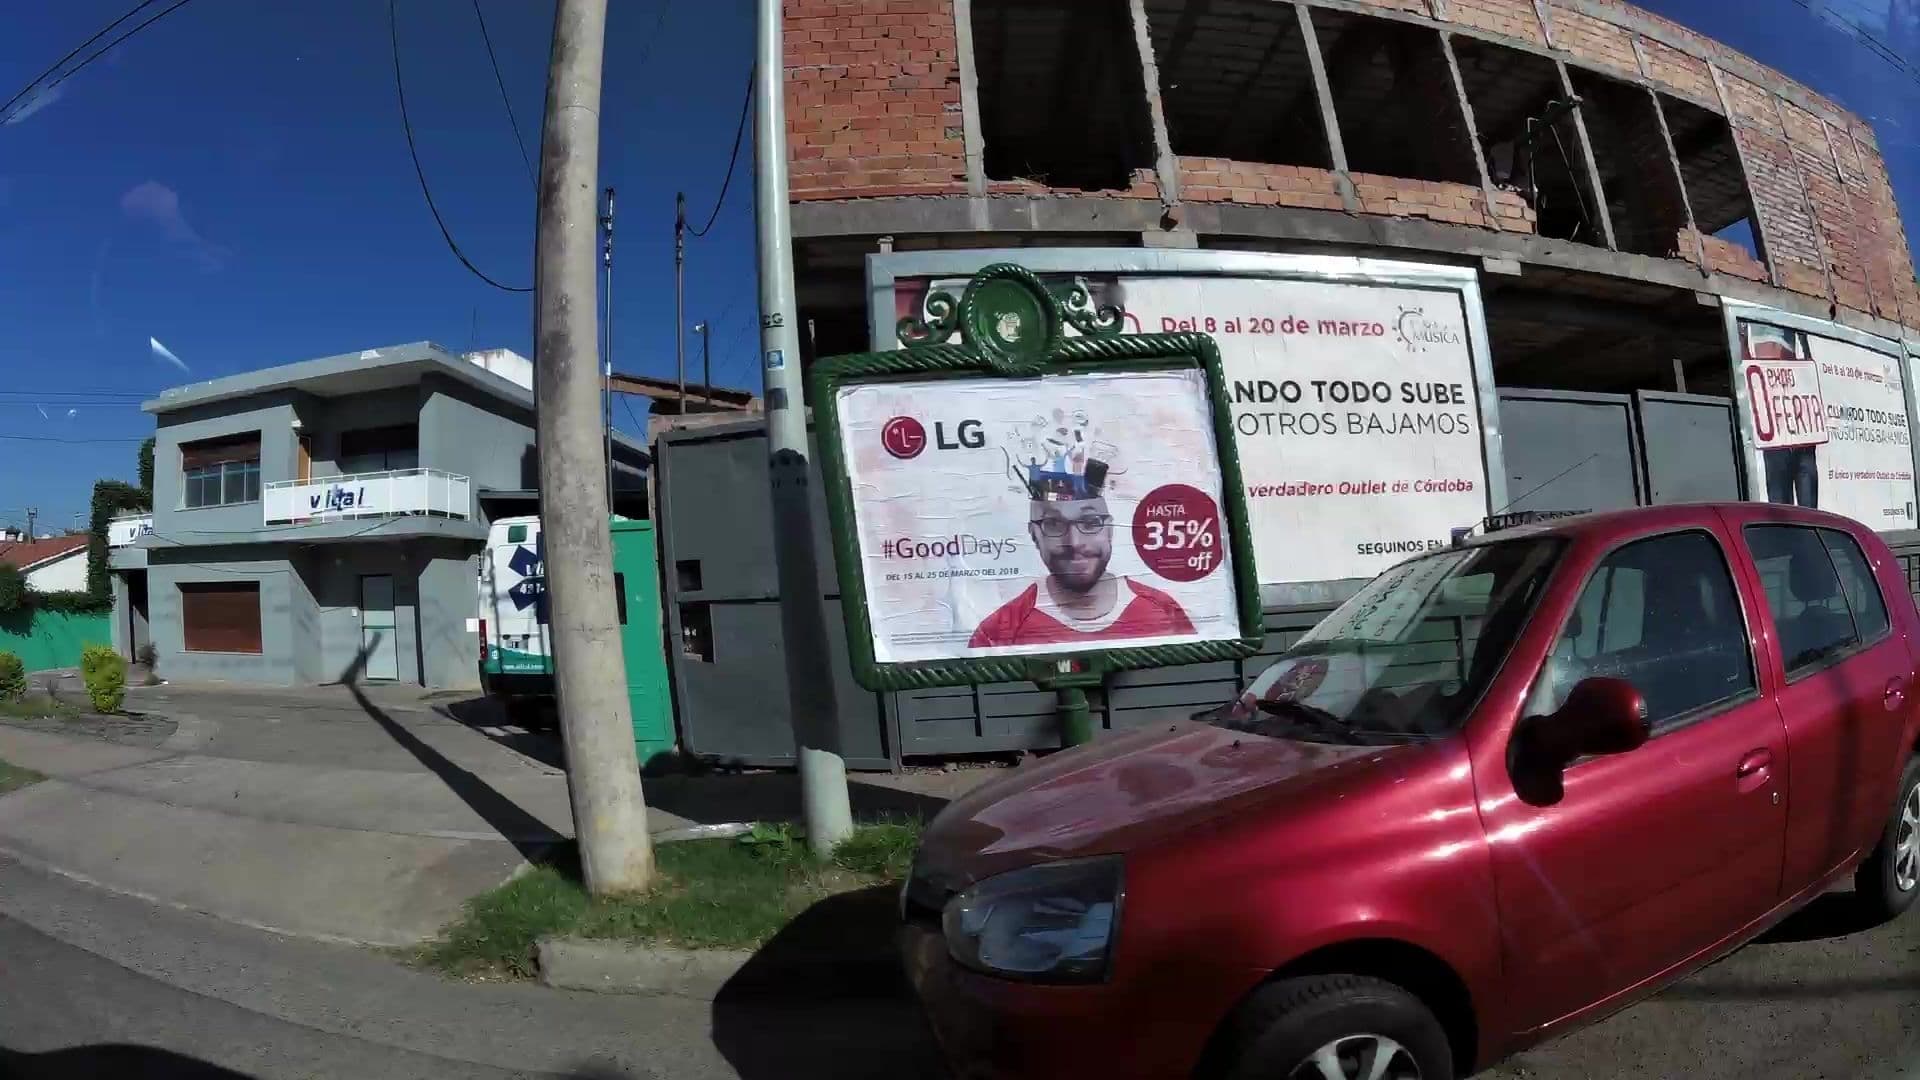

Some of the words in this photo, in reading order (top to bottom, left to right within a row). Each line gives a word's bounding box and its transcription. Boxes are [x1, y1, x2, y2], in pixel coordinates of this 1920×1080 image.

[1161, 317, 1196, 333] Del
[1204, 317, 1217, 333] 8
[1225, 317, 1241, 333] al
[1249, 318, 1275, 333] 20
[1281, 315, 1310, 333] de
[1317, 319, 1385, 337] marzo
[1311, 380, 1392, 403] TODO
[1400, 382, 1466, 405] SUBE
[934, 419, 986, 450] LG
[1347, 412, 1471, 436] BAJAMOS
[1249, 481, 1333, 497] verdadero
[1338, 479, 1386, 495] Outlet
[1391, 480, 1409, 492] de
[1414, 478, 1474, 492] Córdoba
[1146, 504, 1186, 517] HASTA
[1142, 517, 1214, 550] 35%
[882, 534, 1017, 560] #GoodDays
[1357, 540, 1424, 555] SEGUINOS
[1187, 551, 1213, 571] off
[886, 573, 901, 581] DEL
[903, 572, 913, 580] 15
[914, 570, 926, 579] AL
[927, 571, 938, 579] 25
[938, 570, 949, 578] DE
[981, 568, 997, 576] DEL
[999, 567, 1020, 575] 2018
